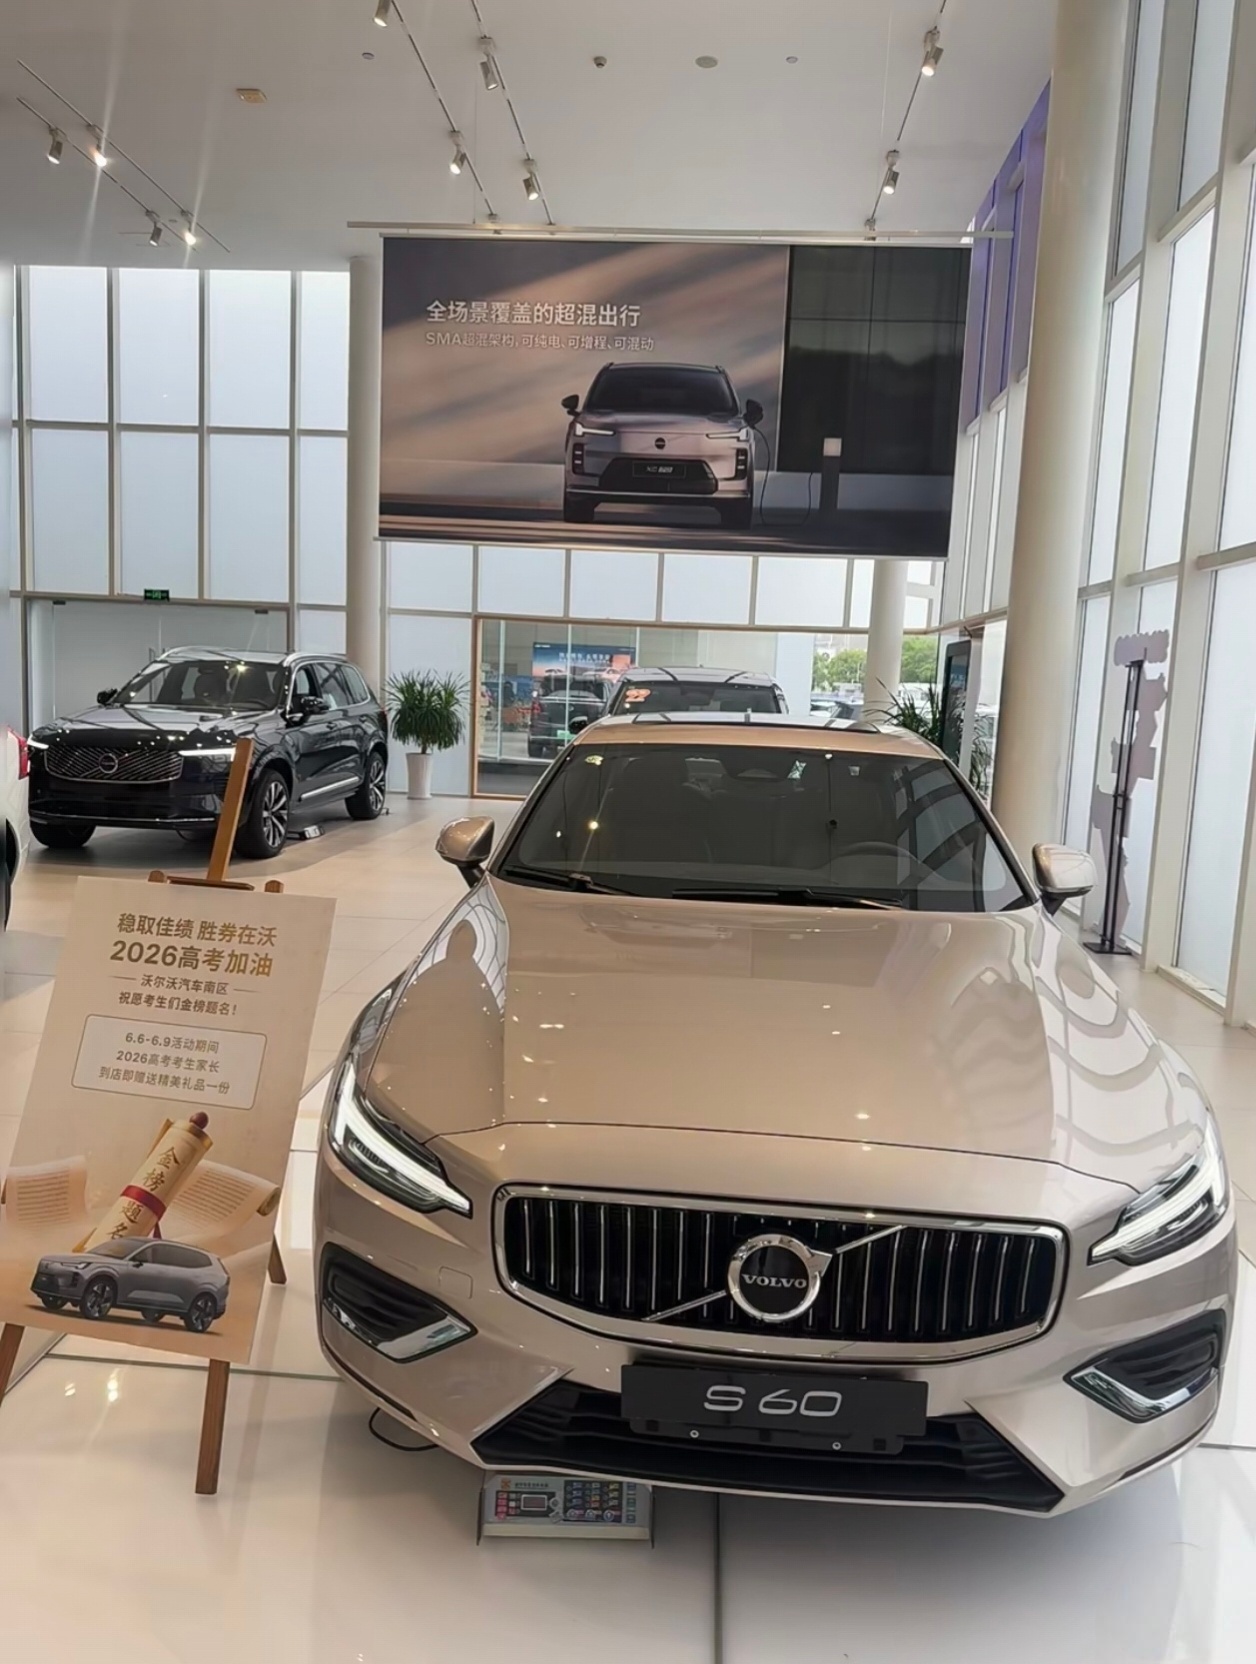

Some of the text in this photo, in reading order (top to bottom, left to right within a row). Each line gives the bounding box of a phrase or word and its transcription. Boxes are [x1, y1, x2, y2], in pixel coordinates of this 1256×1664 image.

[426, 300, 641, 327] 全场景覆盖的超混出行
[117, 912, 278, 947] 稳取佳绩 胜券在沃
[110, 940, 273, 977] 2026高考加油
[140, 974, 229, 995] 沃尔沃汽车南区
[125, 1032, 219, 1054] 6.6-6.9活动期间
[116, 1050, 220, 1074] 2026高考考生家长
[98, 1066, 231, 1095] 到店即赠送精美礼品一份
[743, 1274, 807, 1289] VOLVO
